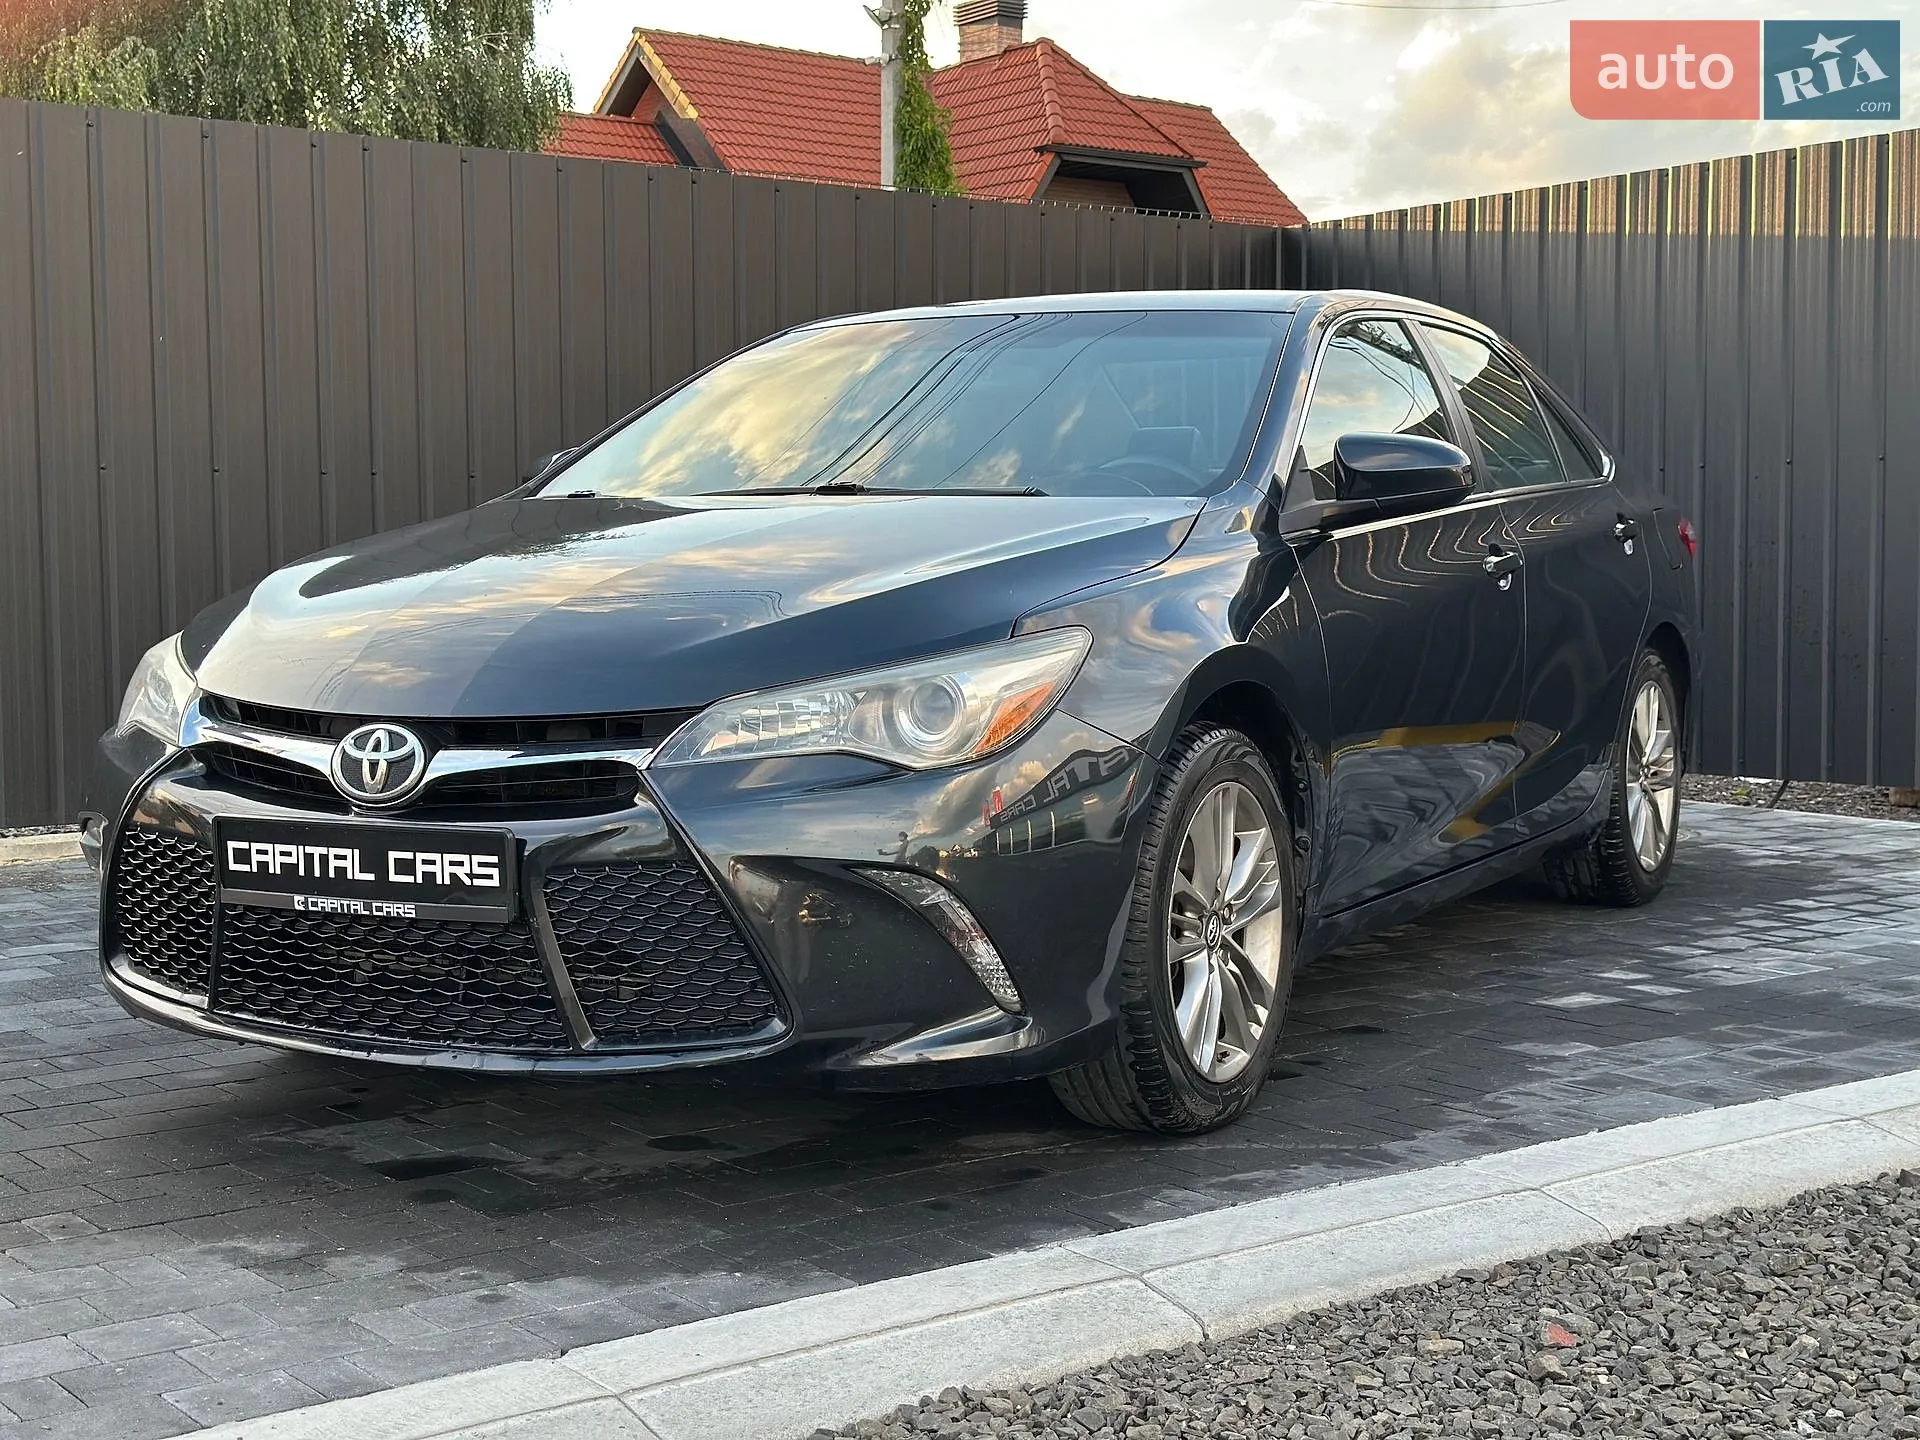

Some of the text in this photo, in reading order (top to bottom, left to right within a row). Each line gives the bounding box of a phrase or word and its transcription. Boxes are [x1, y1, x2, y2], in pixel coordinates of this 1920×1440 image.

[227, 840, 500, 887] CAPITAL CARS
[308, 897, 416, 917] CAPITAL CARS
